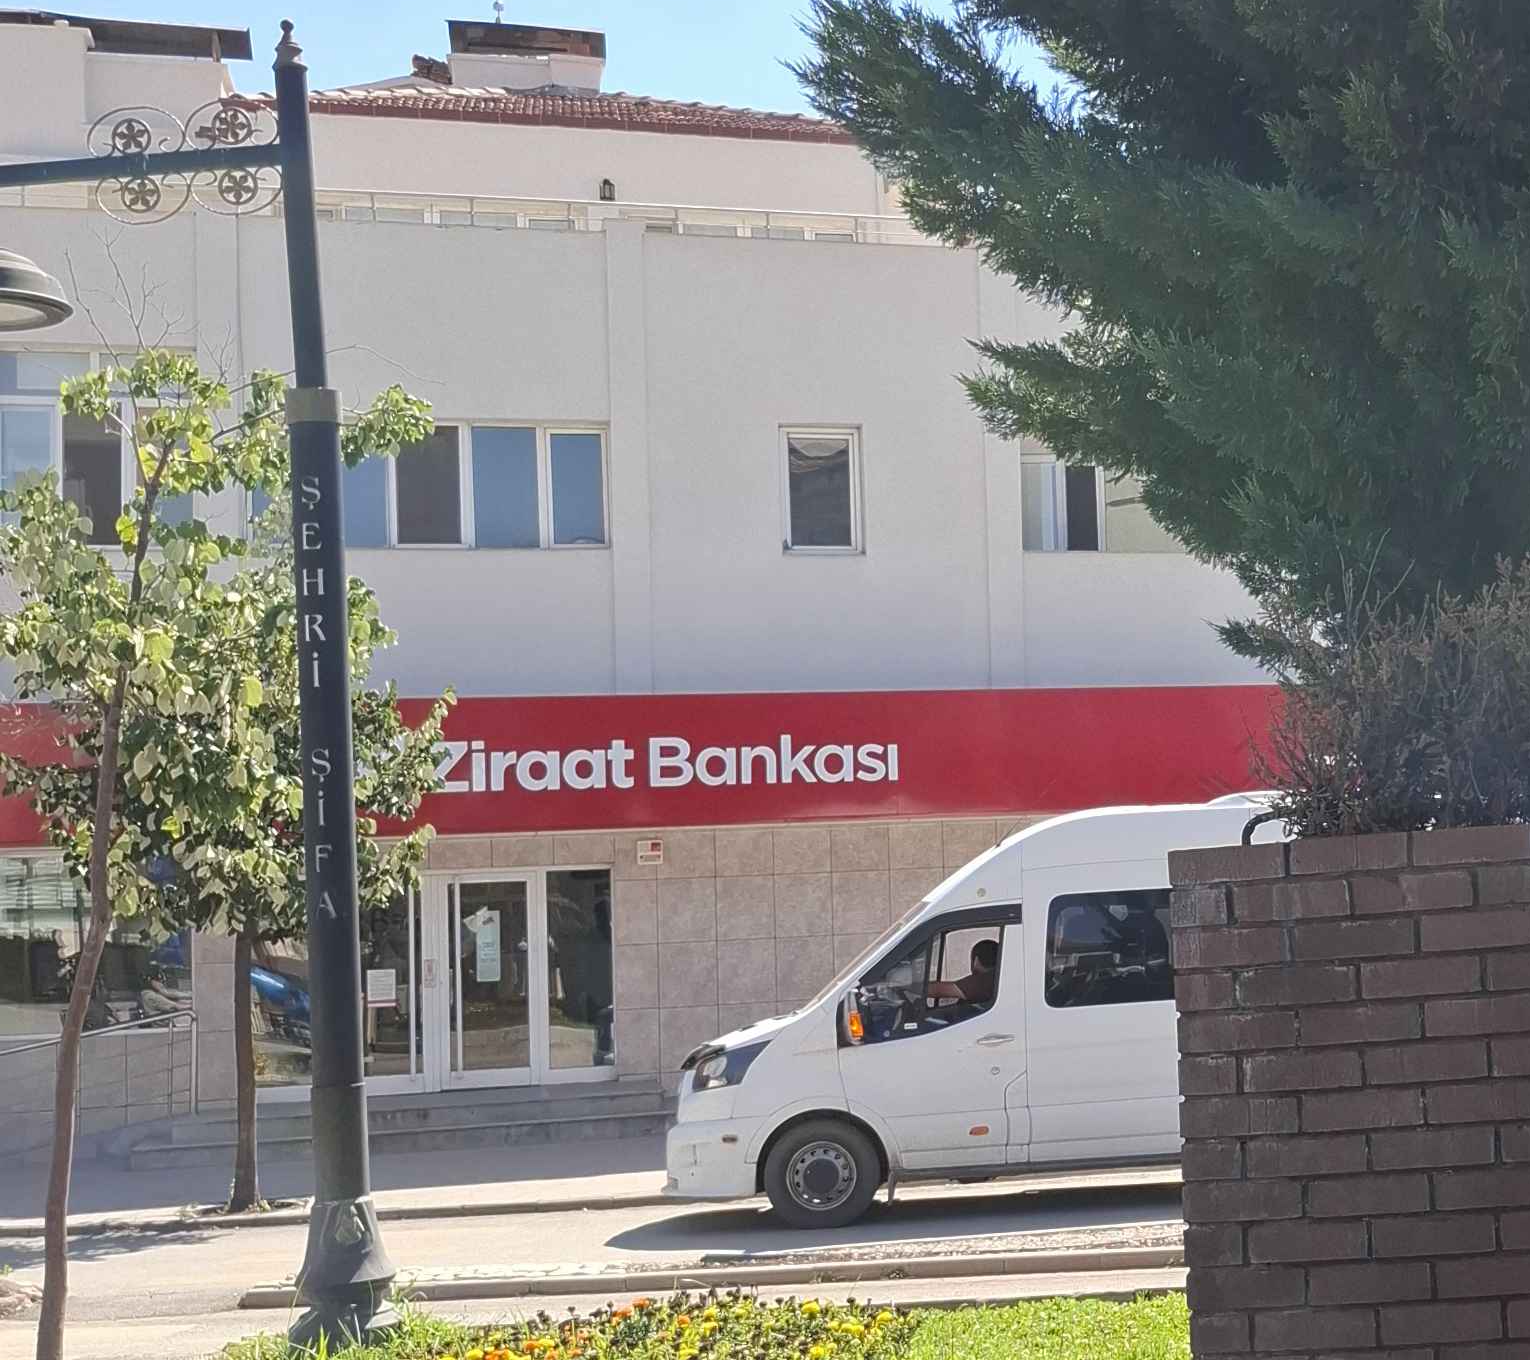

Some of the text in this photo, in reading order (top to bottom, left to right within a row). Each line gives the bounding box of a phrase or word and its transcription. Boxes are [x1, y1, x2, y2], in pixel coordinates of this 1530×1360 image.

[300, 475, 338, 921] ŞEHRİ ŞİFA
[431, 734, 899, 794] Ziraat Bankası
